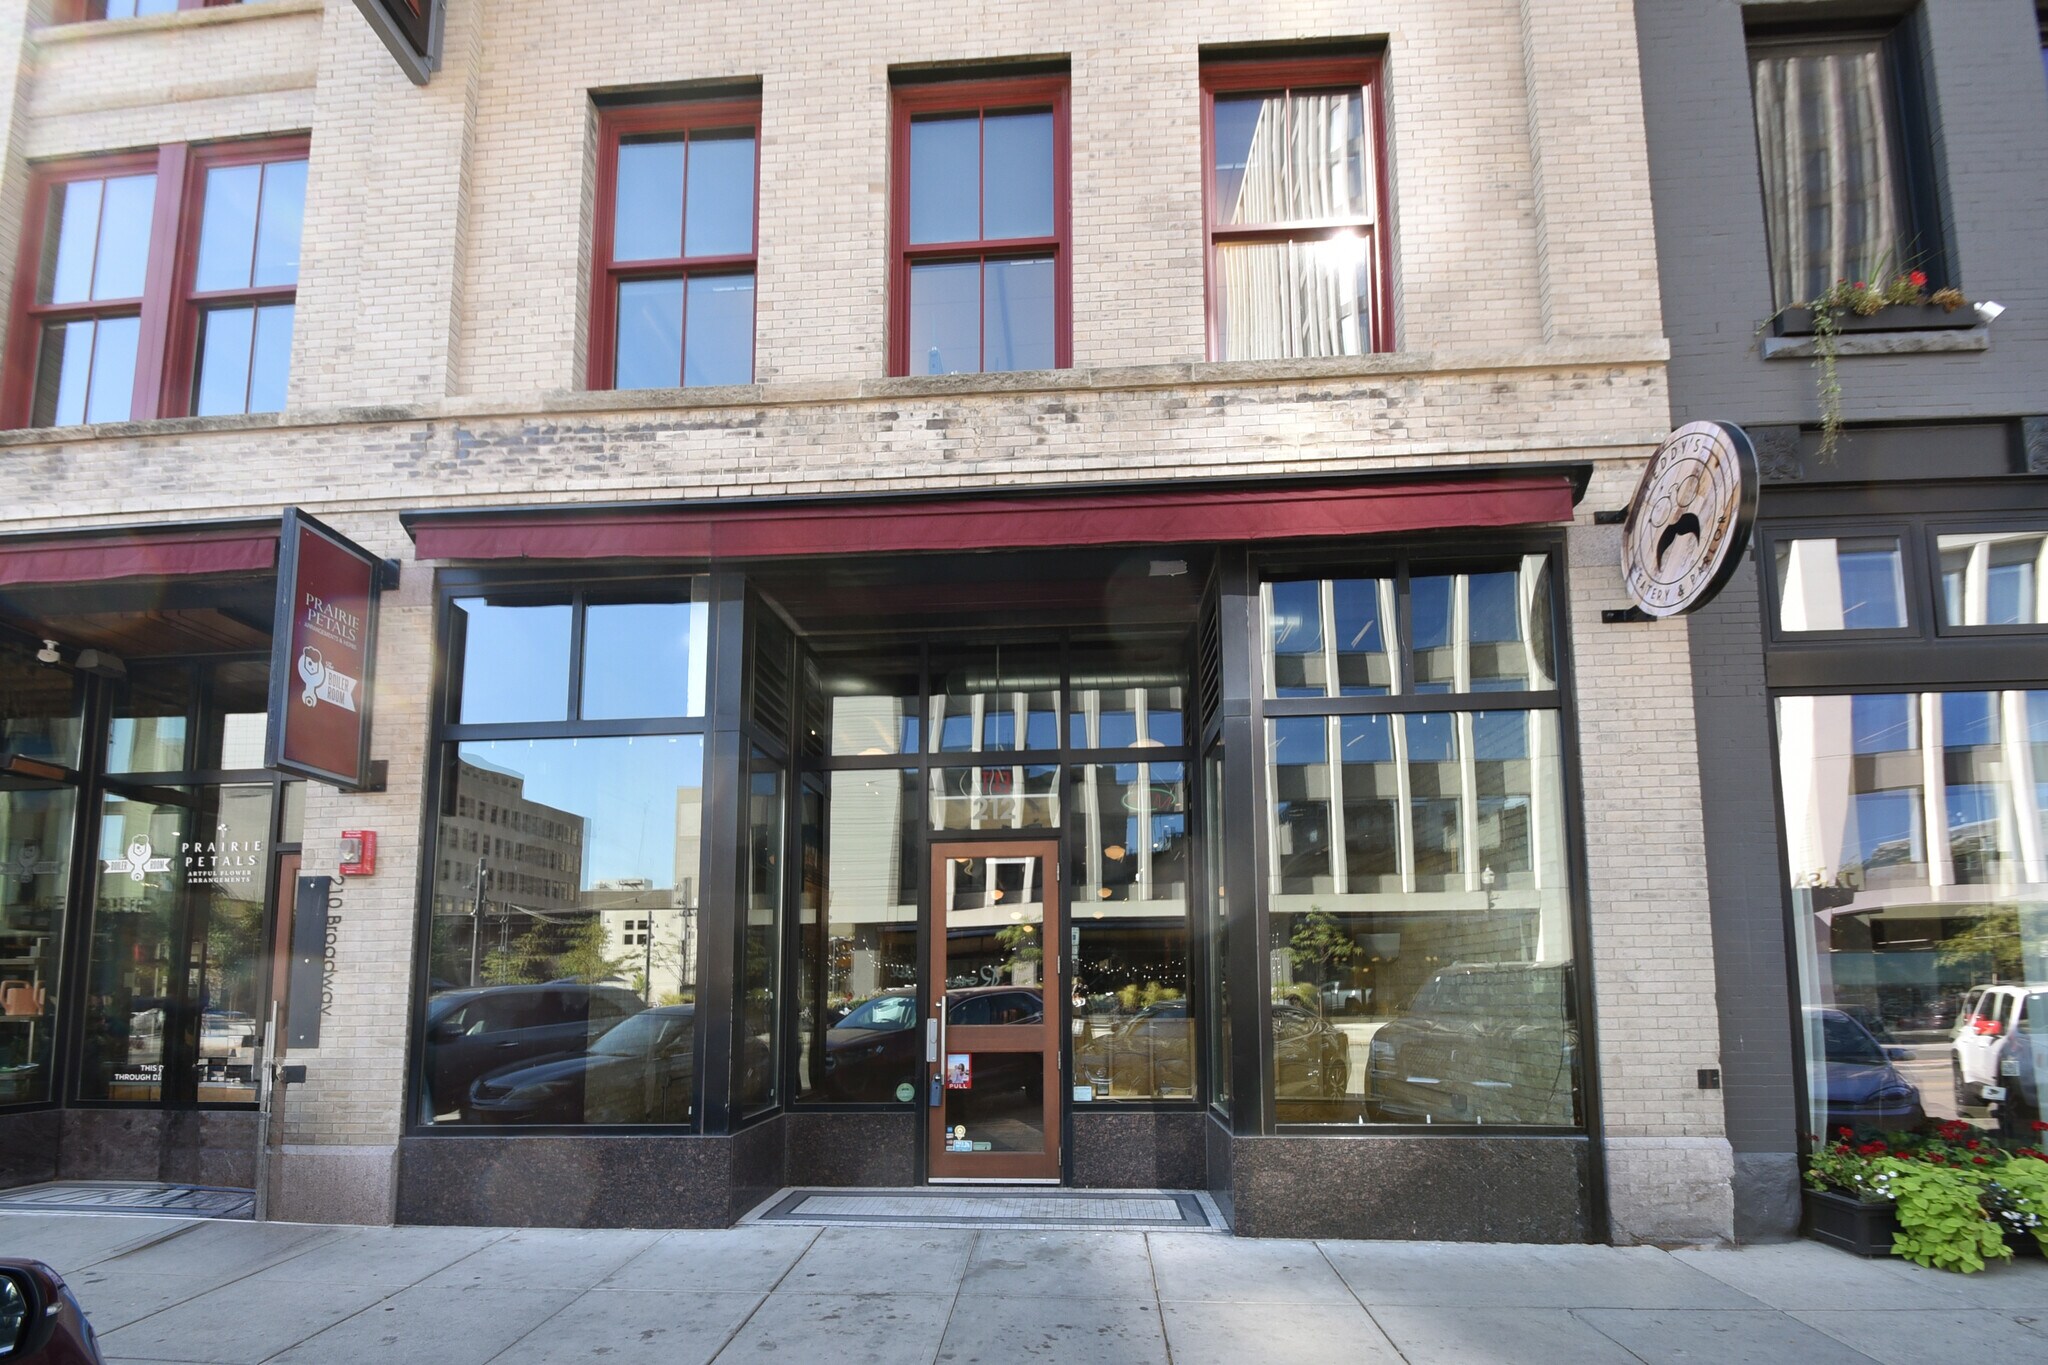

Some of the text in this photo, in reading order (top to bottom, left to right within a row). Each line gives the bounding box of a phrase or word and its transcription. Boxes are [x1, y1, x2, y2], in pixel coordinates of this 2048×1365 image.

[1635, 514, 1727, 601] EATERY & PARLOR
[305, 592, 360, 630] PRAIRIE
[308, 608, 356, 641] PETALS
[328, 672, 350, 692] BOILER
[327, 686, 345, 705] ROOM
[972, 797, 1016, 820] 212
[181, 841, 262, 854] PRAIRIE
[110, 860, 164, 872] BOILER ROOM
[185, 855, 257, 868] PETALS
[320, 875, 345, 1016] 210 Broadway
[114, 1073, 151, 1081] THROUGH
[140, 1064, 157, 1072] THIS
